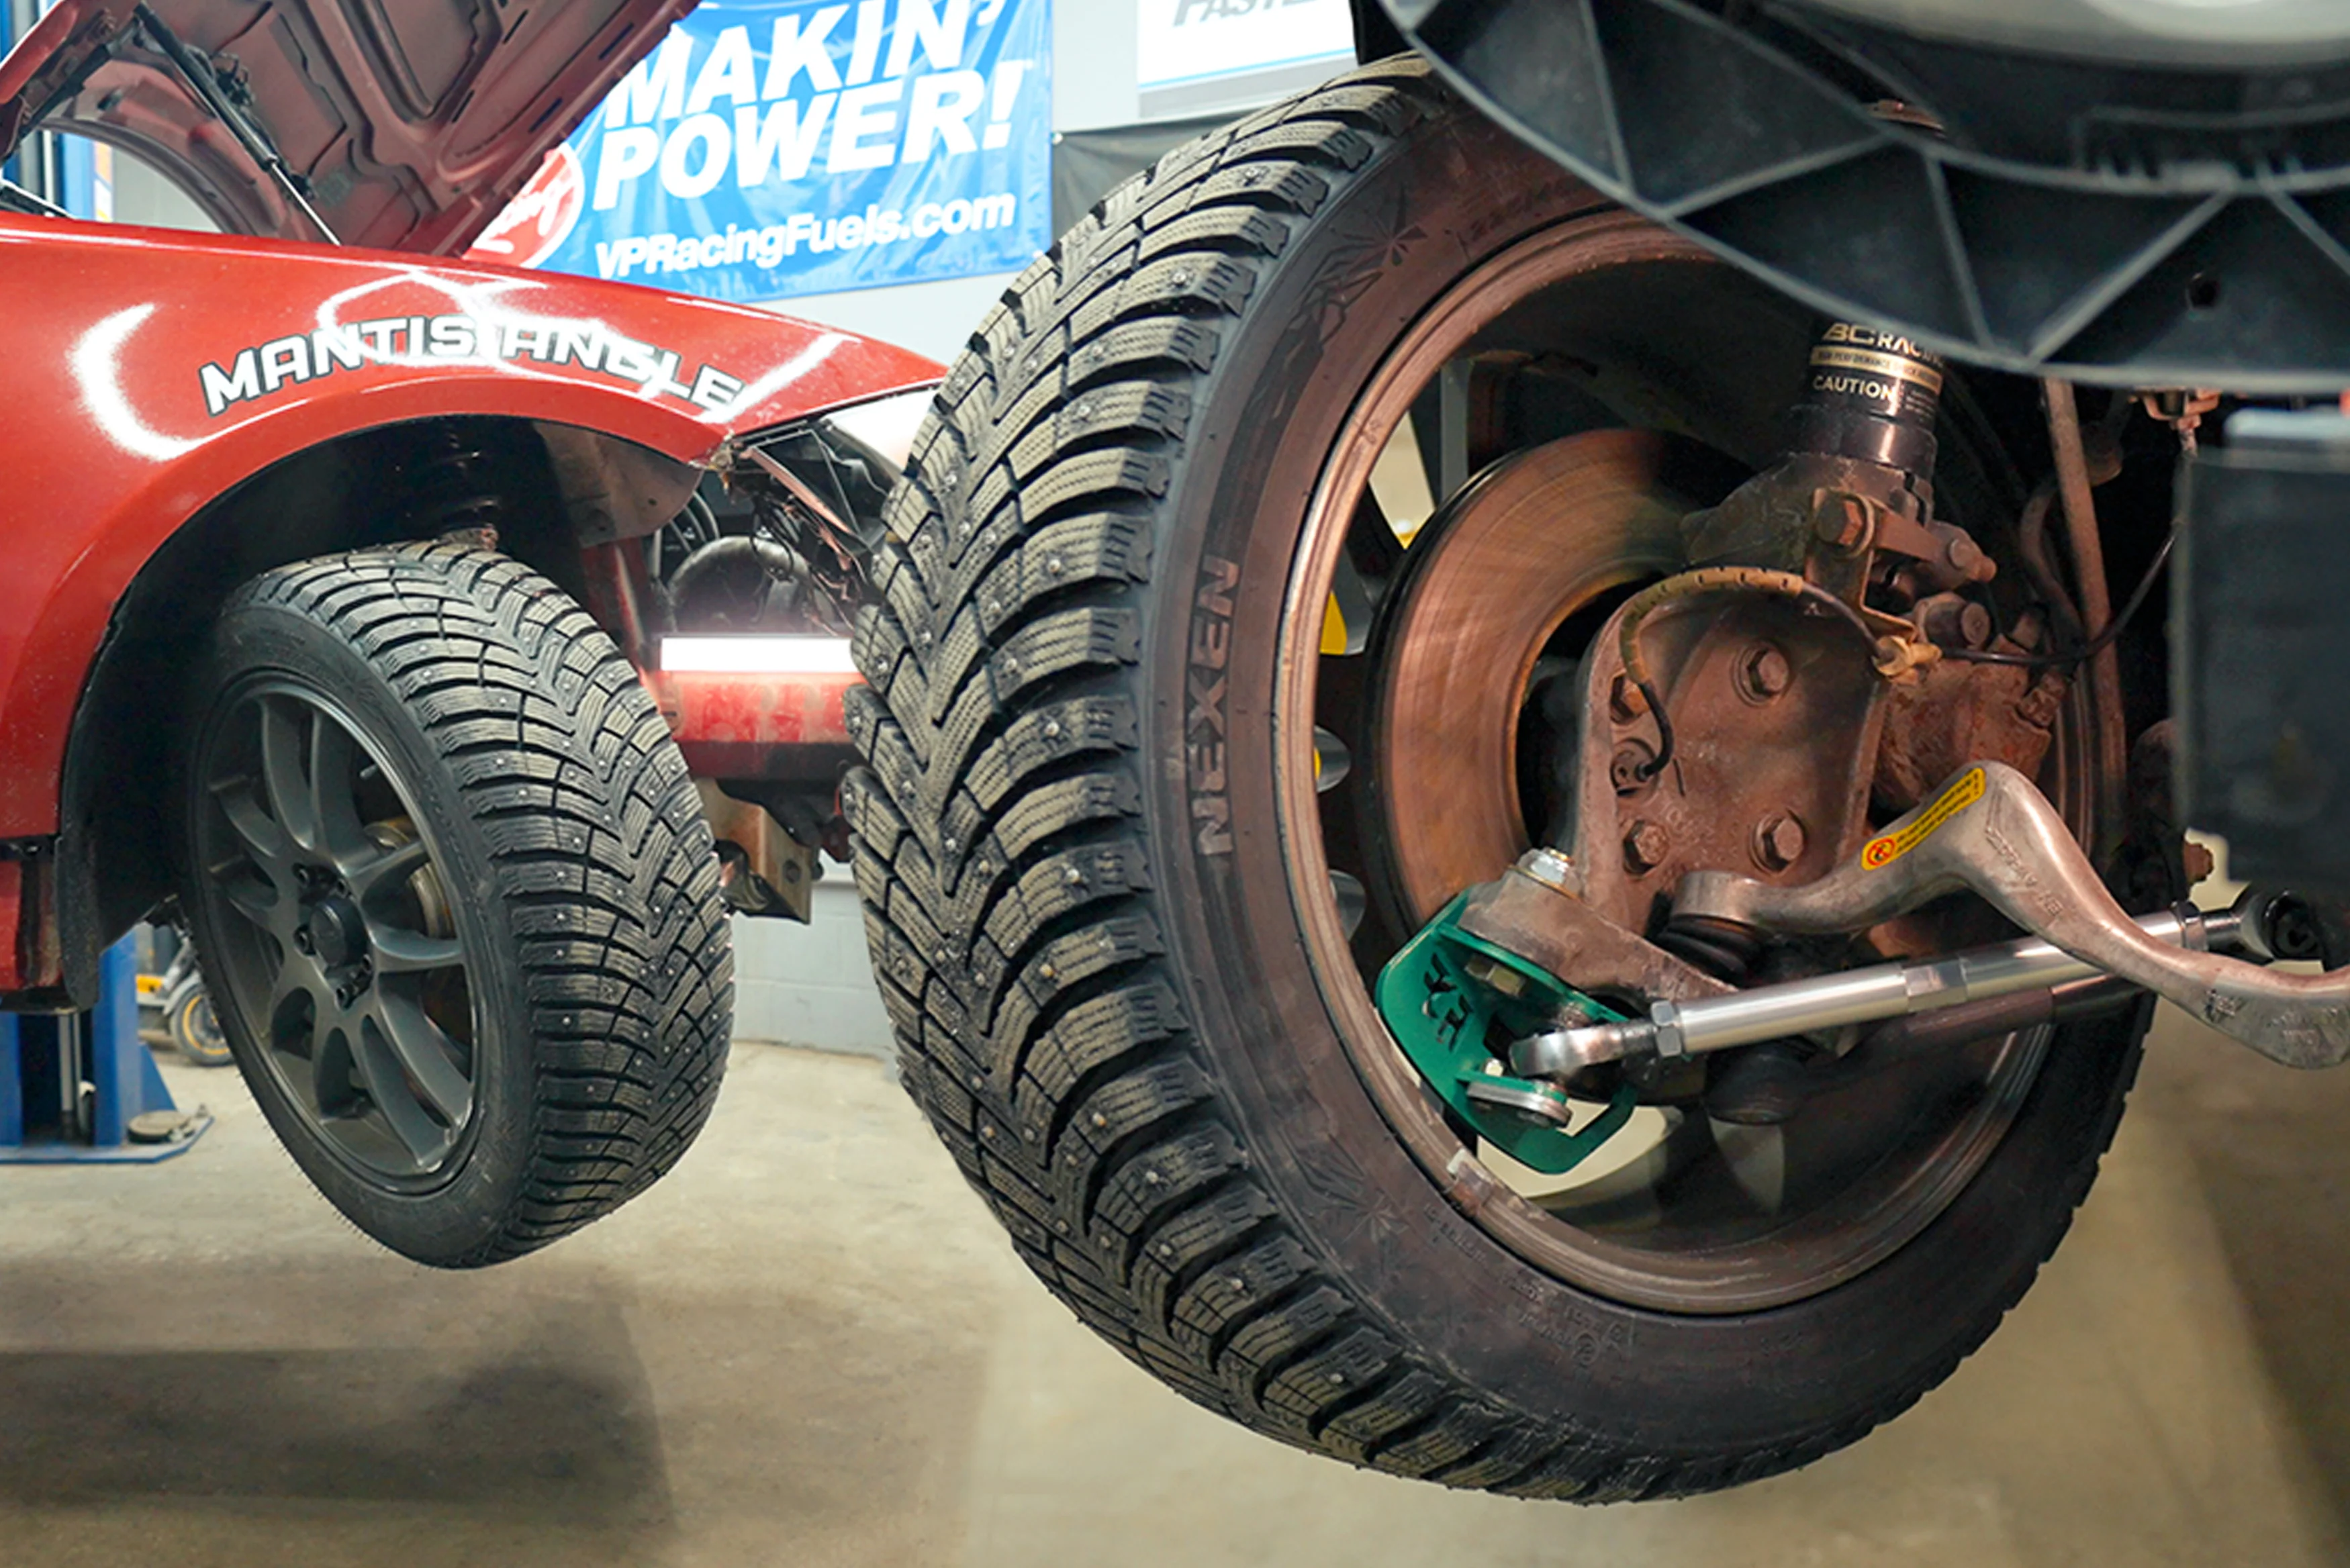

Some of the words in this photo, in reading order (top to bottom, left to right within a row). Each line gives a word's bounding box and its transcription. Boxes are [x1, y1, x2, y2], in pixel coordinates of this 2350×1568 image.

[592, 58, 1027, 211] POWER!
[595, 193, 1016, 279] VPRacingFuels.com
[199, 313, 477, 418] MANTIS
[498, 321, 747, 411] ANGLE
[1813, 375, 1896, 401] CAUTION
[1187, 554, 1240, 856] NEXEN
